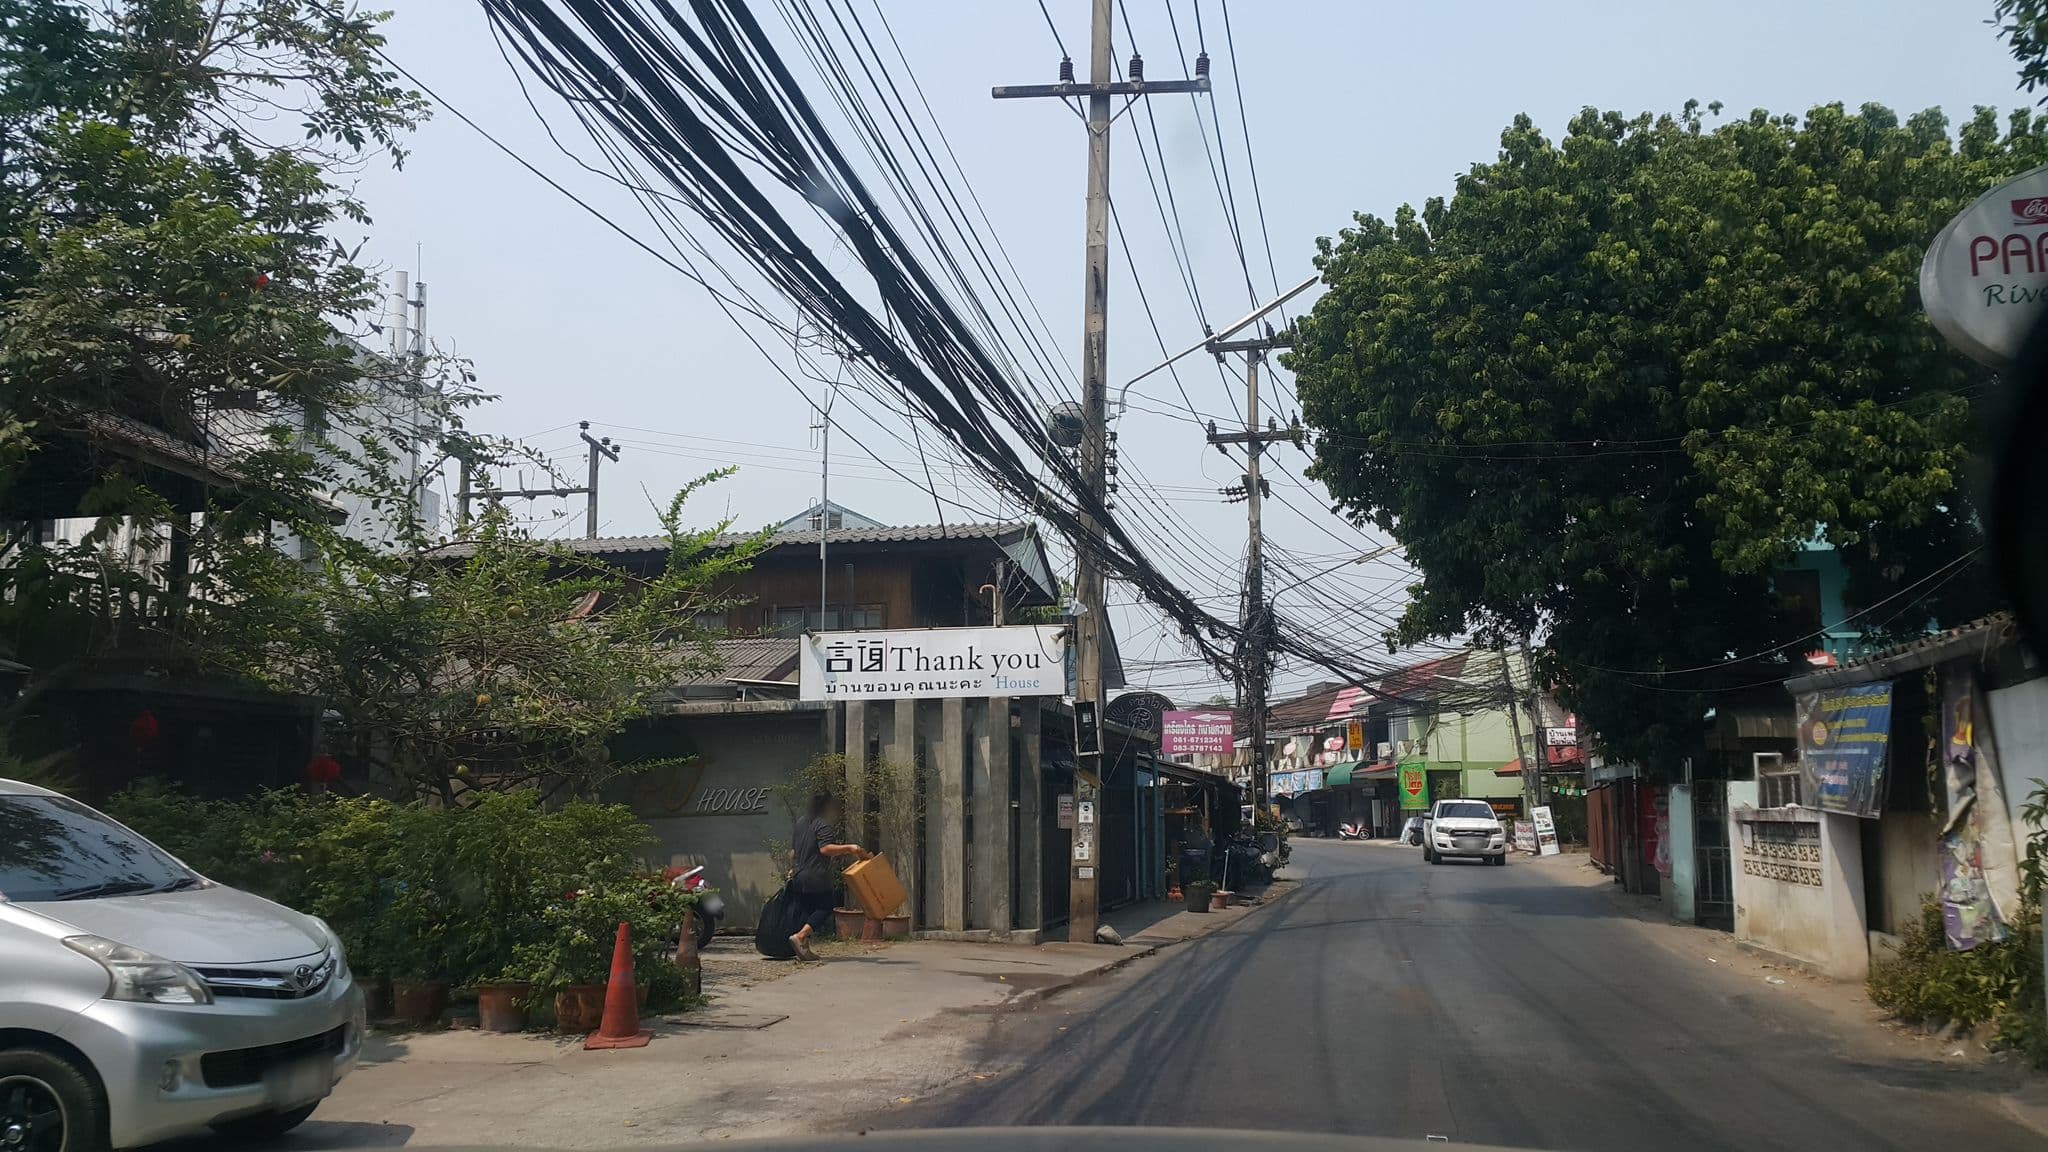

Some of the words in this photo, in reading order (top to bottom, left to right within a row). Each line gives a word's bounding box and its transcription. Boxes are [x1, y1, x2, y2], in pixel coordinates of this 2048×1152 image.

[890, 646, 984, 671] Thank
[991, 653, 1040, 678] you
[826, 680, 982, 695] บ้านขอบคุณนะคะ
[996, 676, 1040, 689] House
[696, 787, 772, 812] HOUSE
